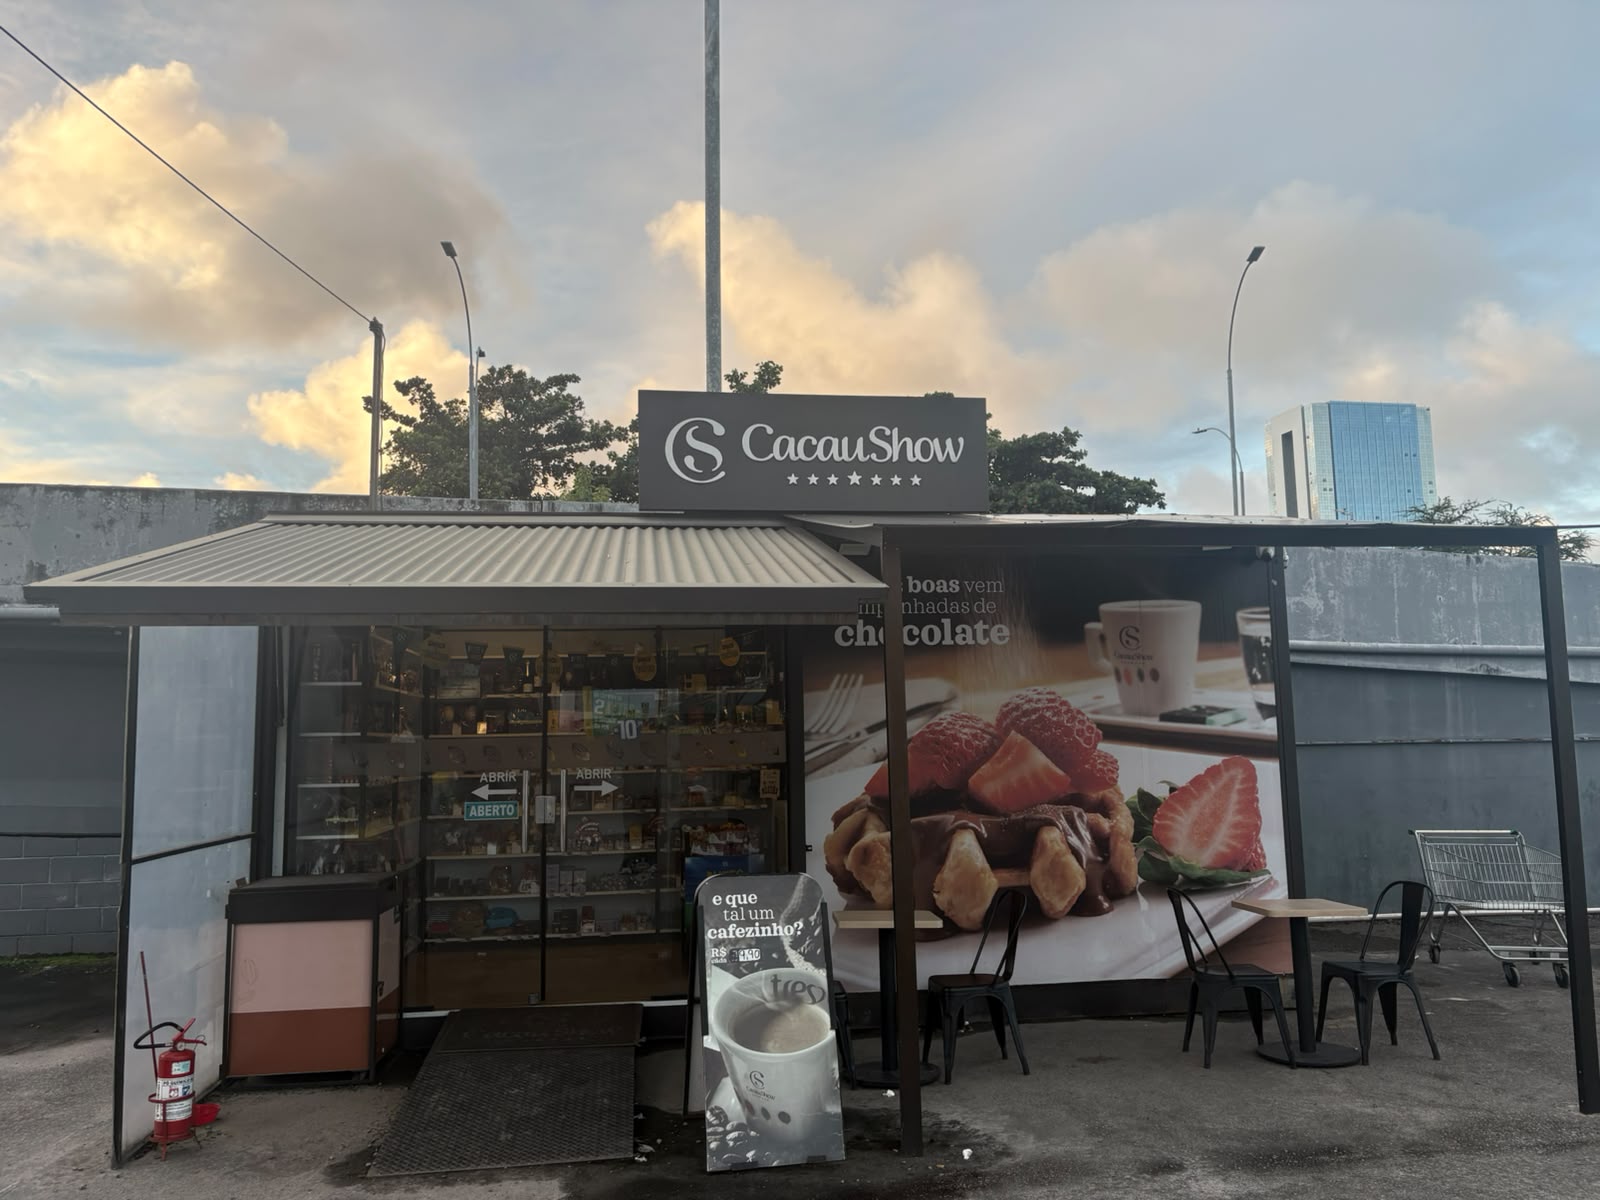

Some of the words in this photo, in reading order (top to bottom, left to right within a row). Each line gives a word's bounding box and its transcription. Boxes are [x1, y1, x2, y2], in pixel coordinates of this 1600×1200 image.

[906, 576, 960, 593] boas
[963, 579, 1004, 593] vem
[973, 598, 997, 614] de
[834, 618, 1010, 646] chcolate
[479, 771, 518, 783] ABRIR
[575, 768, 613, 780] ABRIR
[469, 804, 515, 817] ABERTO
[712, 894, 722, 905] e
[725, 893, 758, 908] que
[723, 907, 745, 921] tal
[748, 908, 774, 920] um
[707, 921, 804, 939] cafezinho?
[711, 946, 727, 958] R$
